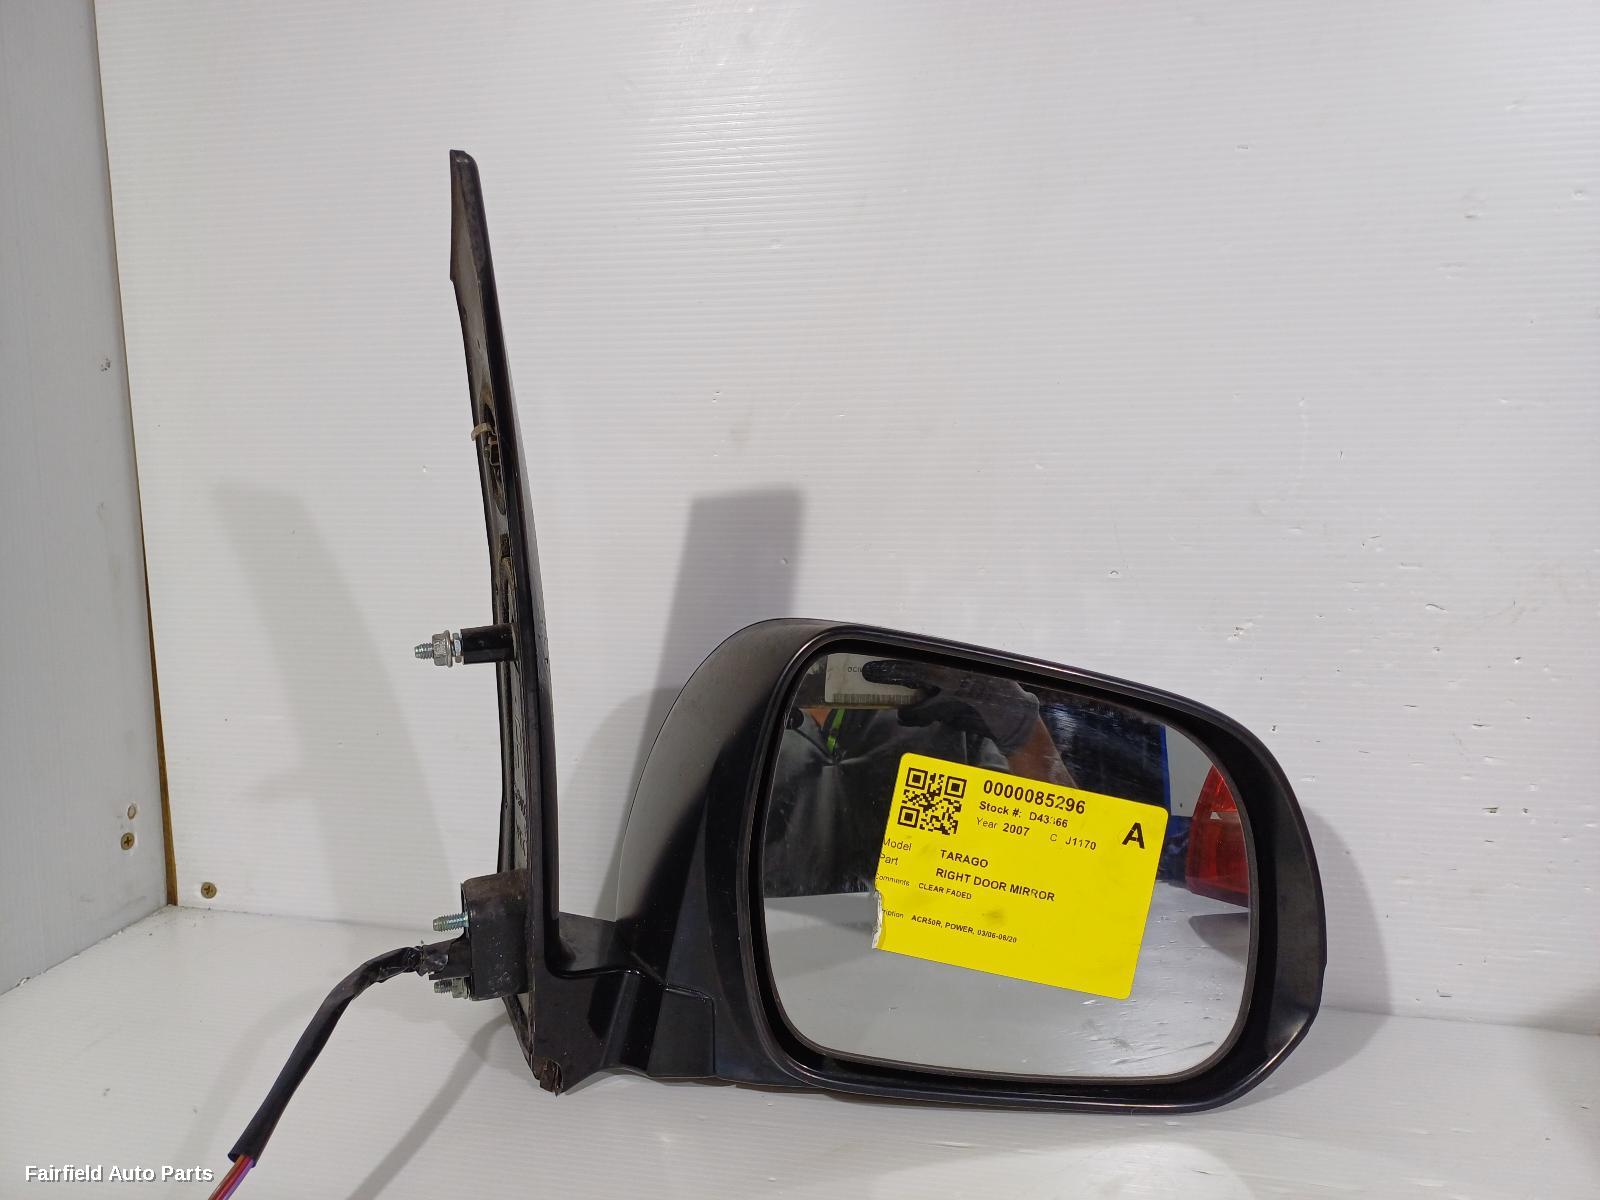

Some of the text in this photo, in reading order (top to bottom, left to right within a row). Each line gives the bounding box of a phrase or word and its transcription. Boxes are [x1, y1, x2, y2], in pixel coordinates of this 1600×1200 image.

[983, 779, 1086, 814] 0000085296
[979, 801, 1009, 815] Stock
[1012, 808, 1022, 818] #:
[976, 817, 1030, 836] Year 2007
[1121, 822, 1146, 849] A
[1066, 836, 1097, 850] J1170
[883, 838, 988, 868] Model TARAGO
[918, 882, 944, 894] CLEAR
[946, 888, 972, 900] FADED
[936, 868, 971, 884] RIGHT
[973, 876, 1007, 891] DOOR
[1009, 883, 1055, 901] MIRROR
[944, 922, 975, 935] POWER,
